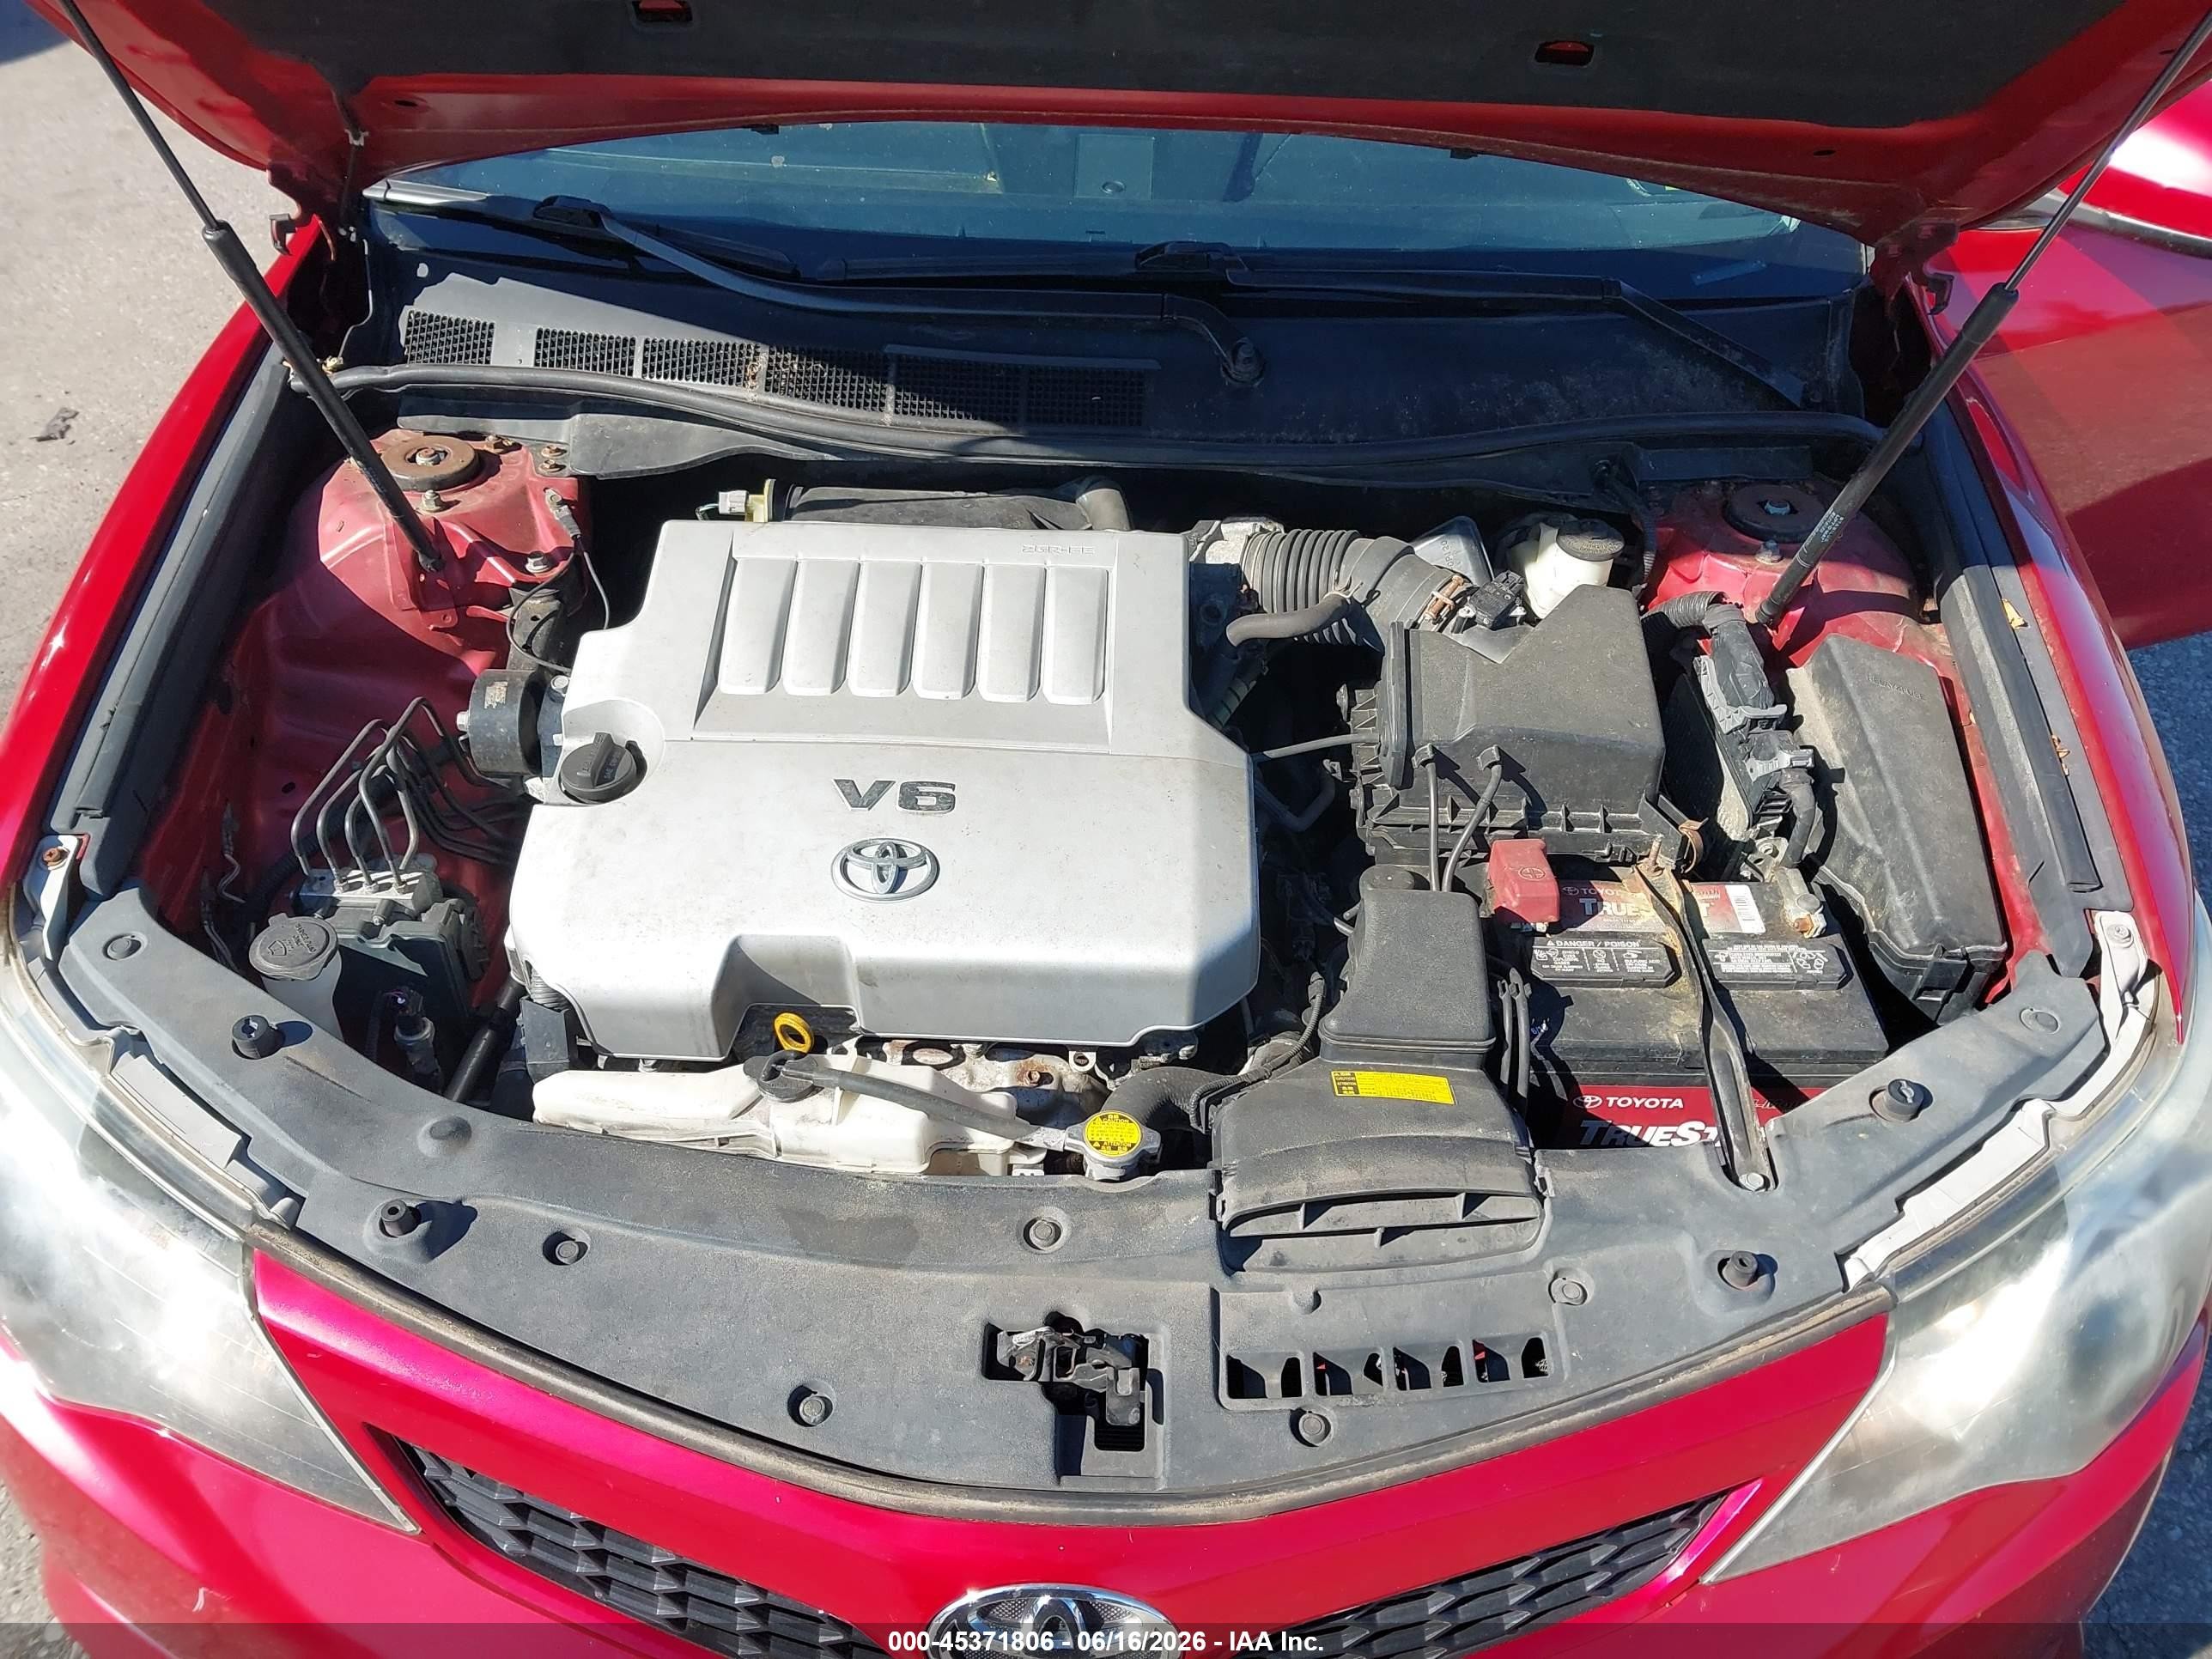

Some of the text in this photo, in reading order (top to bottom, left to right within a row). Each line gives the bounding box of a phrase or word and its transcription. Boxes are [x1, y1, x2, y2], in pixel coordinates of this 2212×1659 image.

[834, 778, 956, 813] V6
[1581, 887, 1623, 896] TOYOT
[1607, 1097, 1684, 1109] TOYOTA
